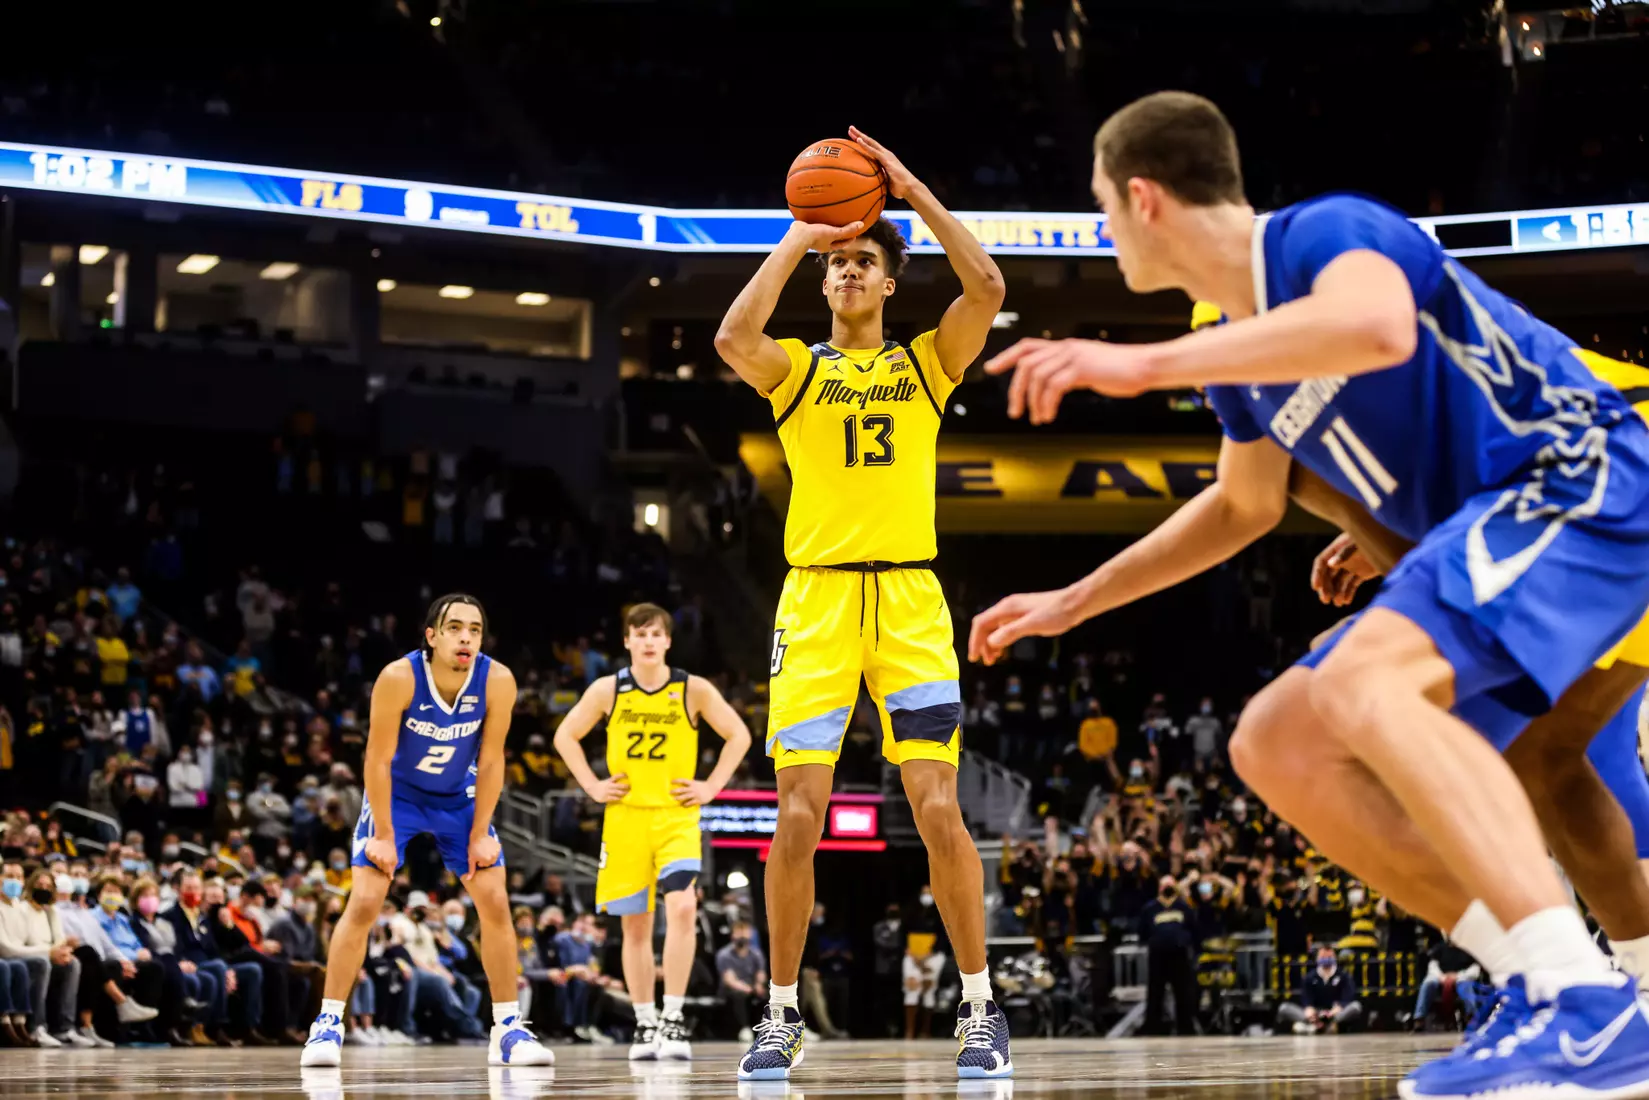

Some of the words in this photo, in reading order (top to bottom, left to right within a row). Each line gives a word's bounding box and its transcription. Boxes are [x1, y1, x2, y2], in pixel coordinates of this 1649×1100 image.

[29, 151, 115, 191] 1:02
[121, 160, 188, 197] PM
[516, 201, 579, 233] TOL
[910, 219, 1099, 247] MQUETTE
[814, 377, 917, 410] Marquette
[843, 413, 895, 467] 13
[1320, 415, 1398, 509] 11
[405, 717, 482, 741] CREIGHTON
[415, 745, 456, 774] 2
[627, 731, 667, 760] 22
